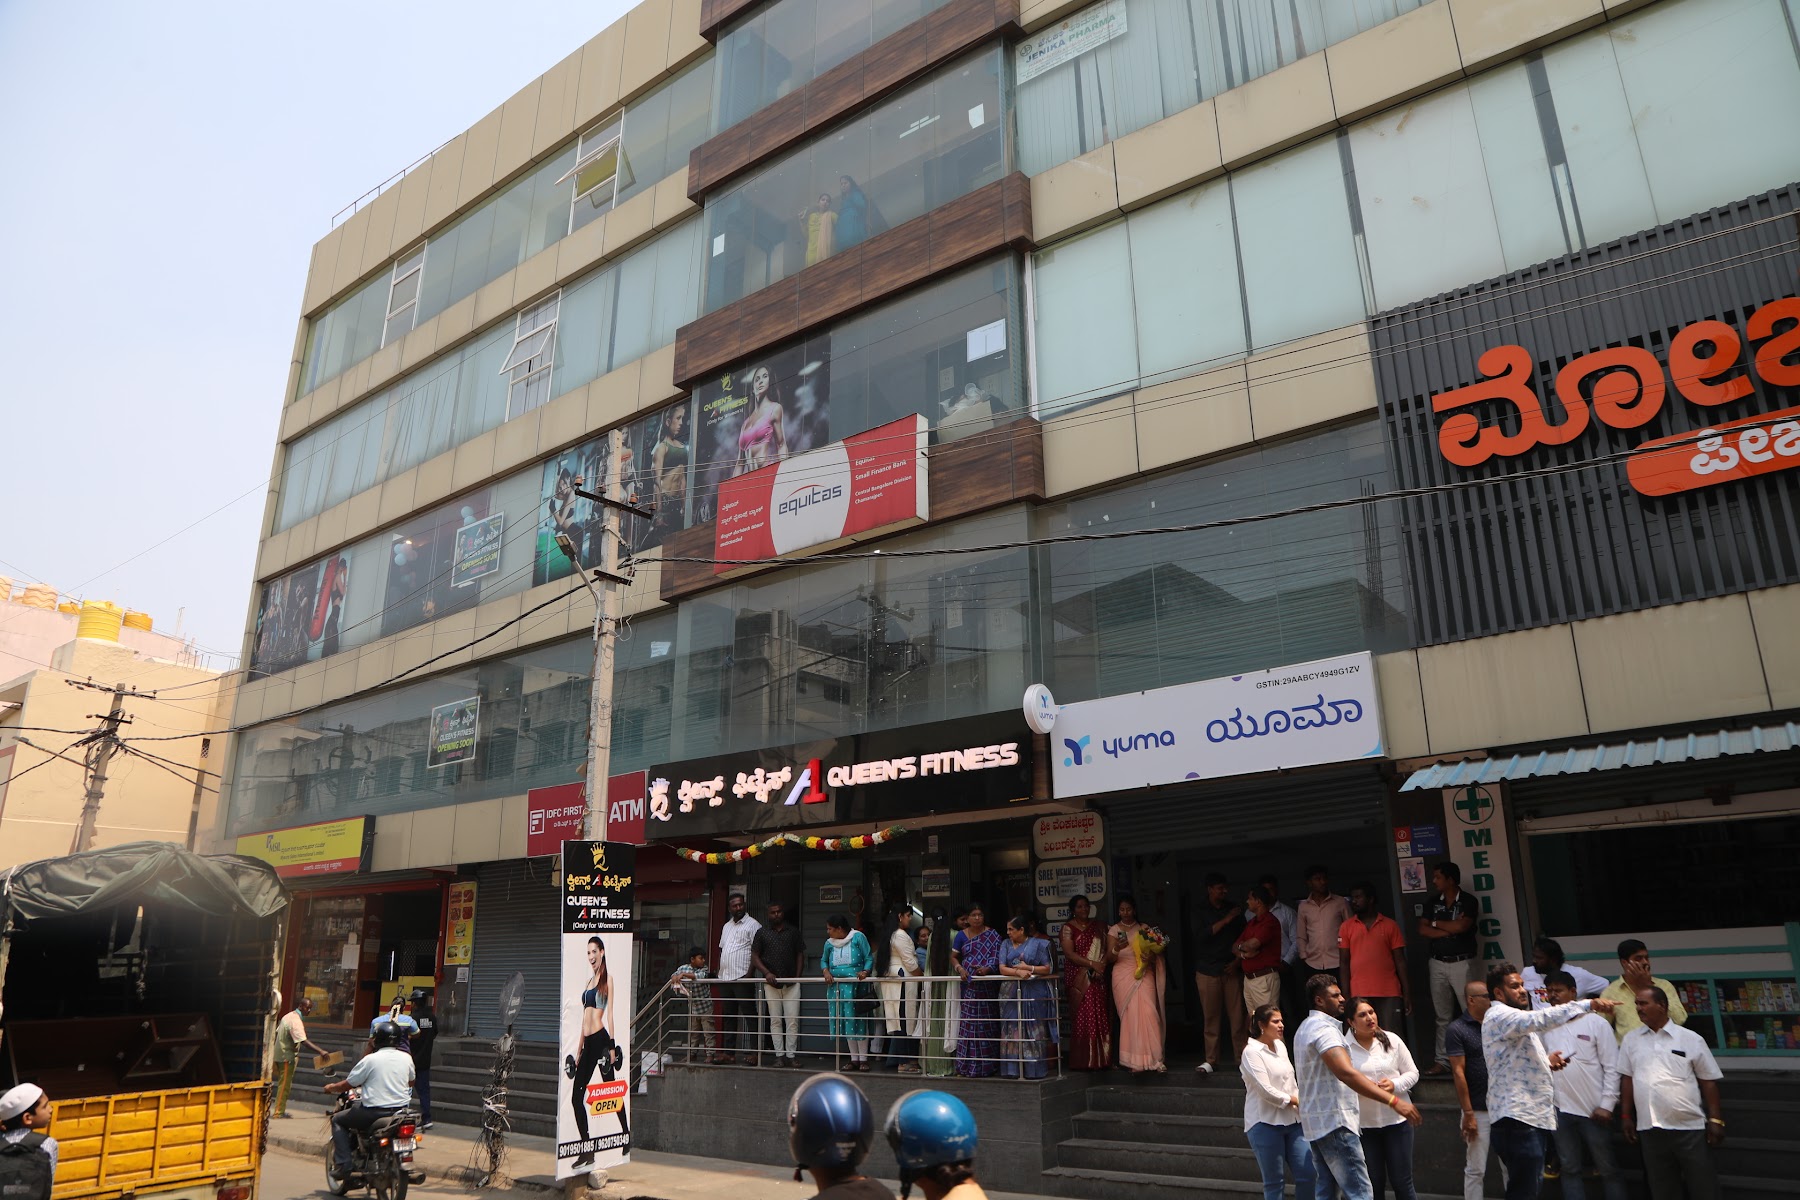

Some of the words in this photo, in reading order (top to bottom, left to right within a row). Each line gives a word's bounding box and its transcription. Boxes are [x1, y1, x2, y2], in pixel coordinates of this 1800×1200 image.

[1026, 39, 1066, 62] JENIKA
[1068, 15, 1116, 41] PHARMA
[719, 397, 749, 413] FITNESS
[855, 470, 870, 481] Small
[871, 464, 892, 476] Finance
[892, 459, 907, 469] Bank
[854, 486, 871, 497] Central
[871, 480, 893, 493] Bangalore
[893, 474, 912, 485] Division
[779, 484, 842, 516] equitas
[1256, 664, 1361, 690] GSTIN:29AABCY4949G1ZV
[1039, 711, 1054, 720] yuma
[1206, 693, 1364, 743] ಯೂಮಾ
[459, 737, 475, 748] SOON
[1102, 730, 1176, 759] yuma
[827, 756, 918, 787] QUEEN'S
[920, 742, 1019, 777] FITNESS
[546, 808, 563, 819] IDFC
[563, 805, 583, 817] FIRST
[608, 798, 644, 824] ATM
[1040, 819, 1051, 836] ಶ್ರೀ
[1038, 869, 1054, 881] SREE
[566, 895, 608, 907] QUEEN'S
[1463, 828, 1506, 971] MEDICA
[590, 908, 631, 919] FITNESS
[572, 922, 589, 930] (Only
[597, 922, 624, 930] Women's)
[591, 1085, 625, 1097] ADMISSION
[595, 1099, 618, 1112] OPEN
[559, 1140, 595, 1157] 9019501885
